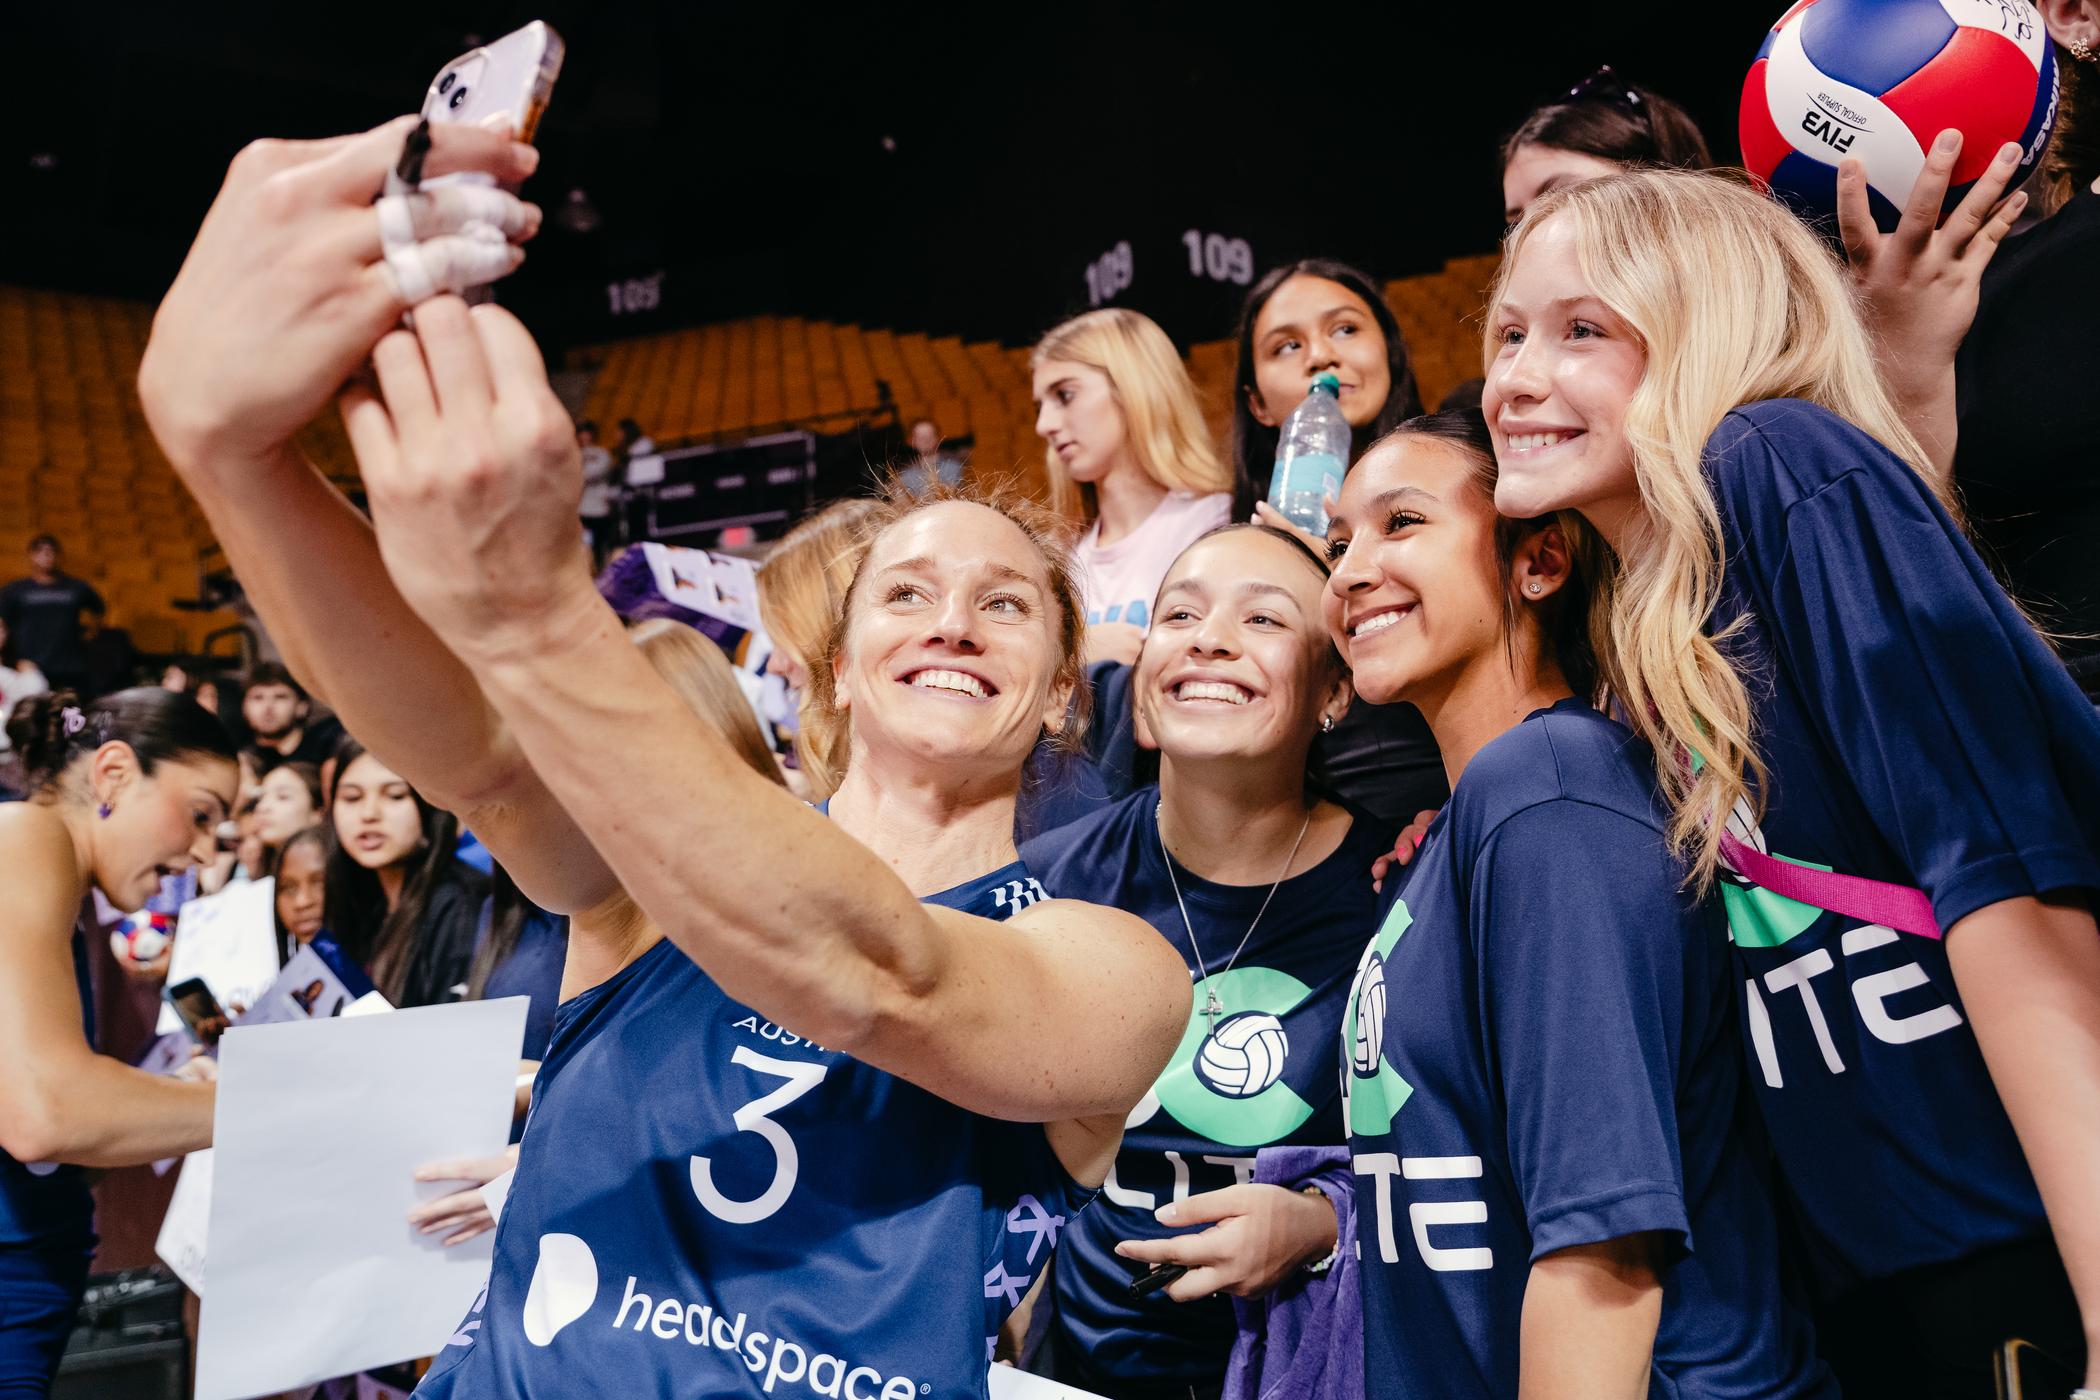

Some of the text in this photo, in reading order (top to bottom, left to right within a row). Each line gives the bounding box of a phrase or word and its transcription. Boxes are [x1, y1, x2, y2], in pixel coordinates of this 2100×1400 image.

[1817, 91, 1867, 125] OFFICIAL SUPPLIER
[2020, 55, 2061, 166] MIKASA
[1181, 229, 1254, 286] 109
[690, 1044, 828, 1225] 3
